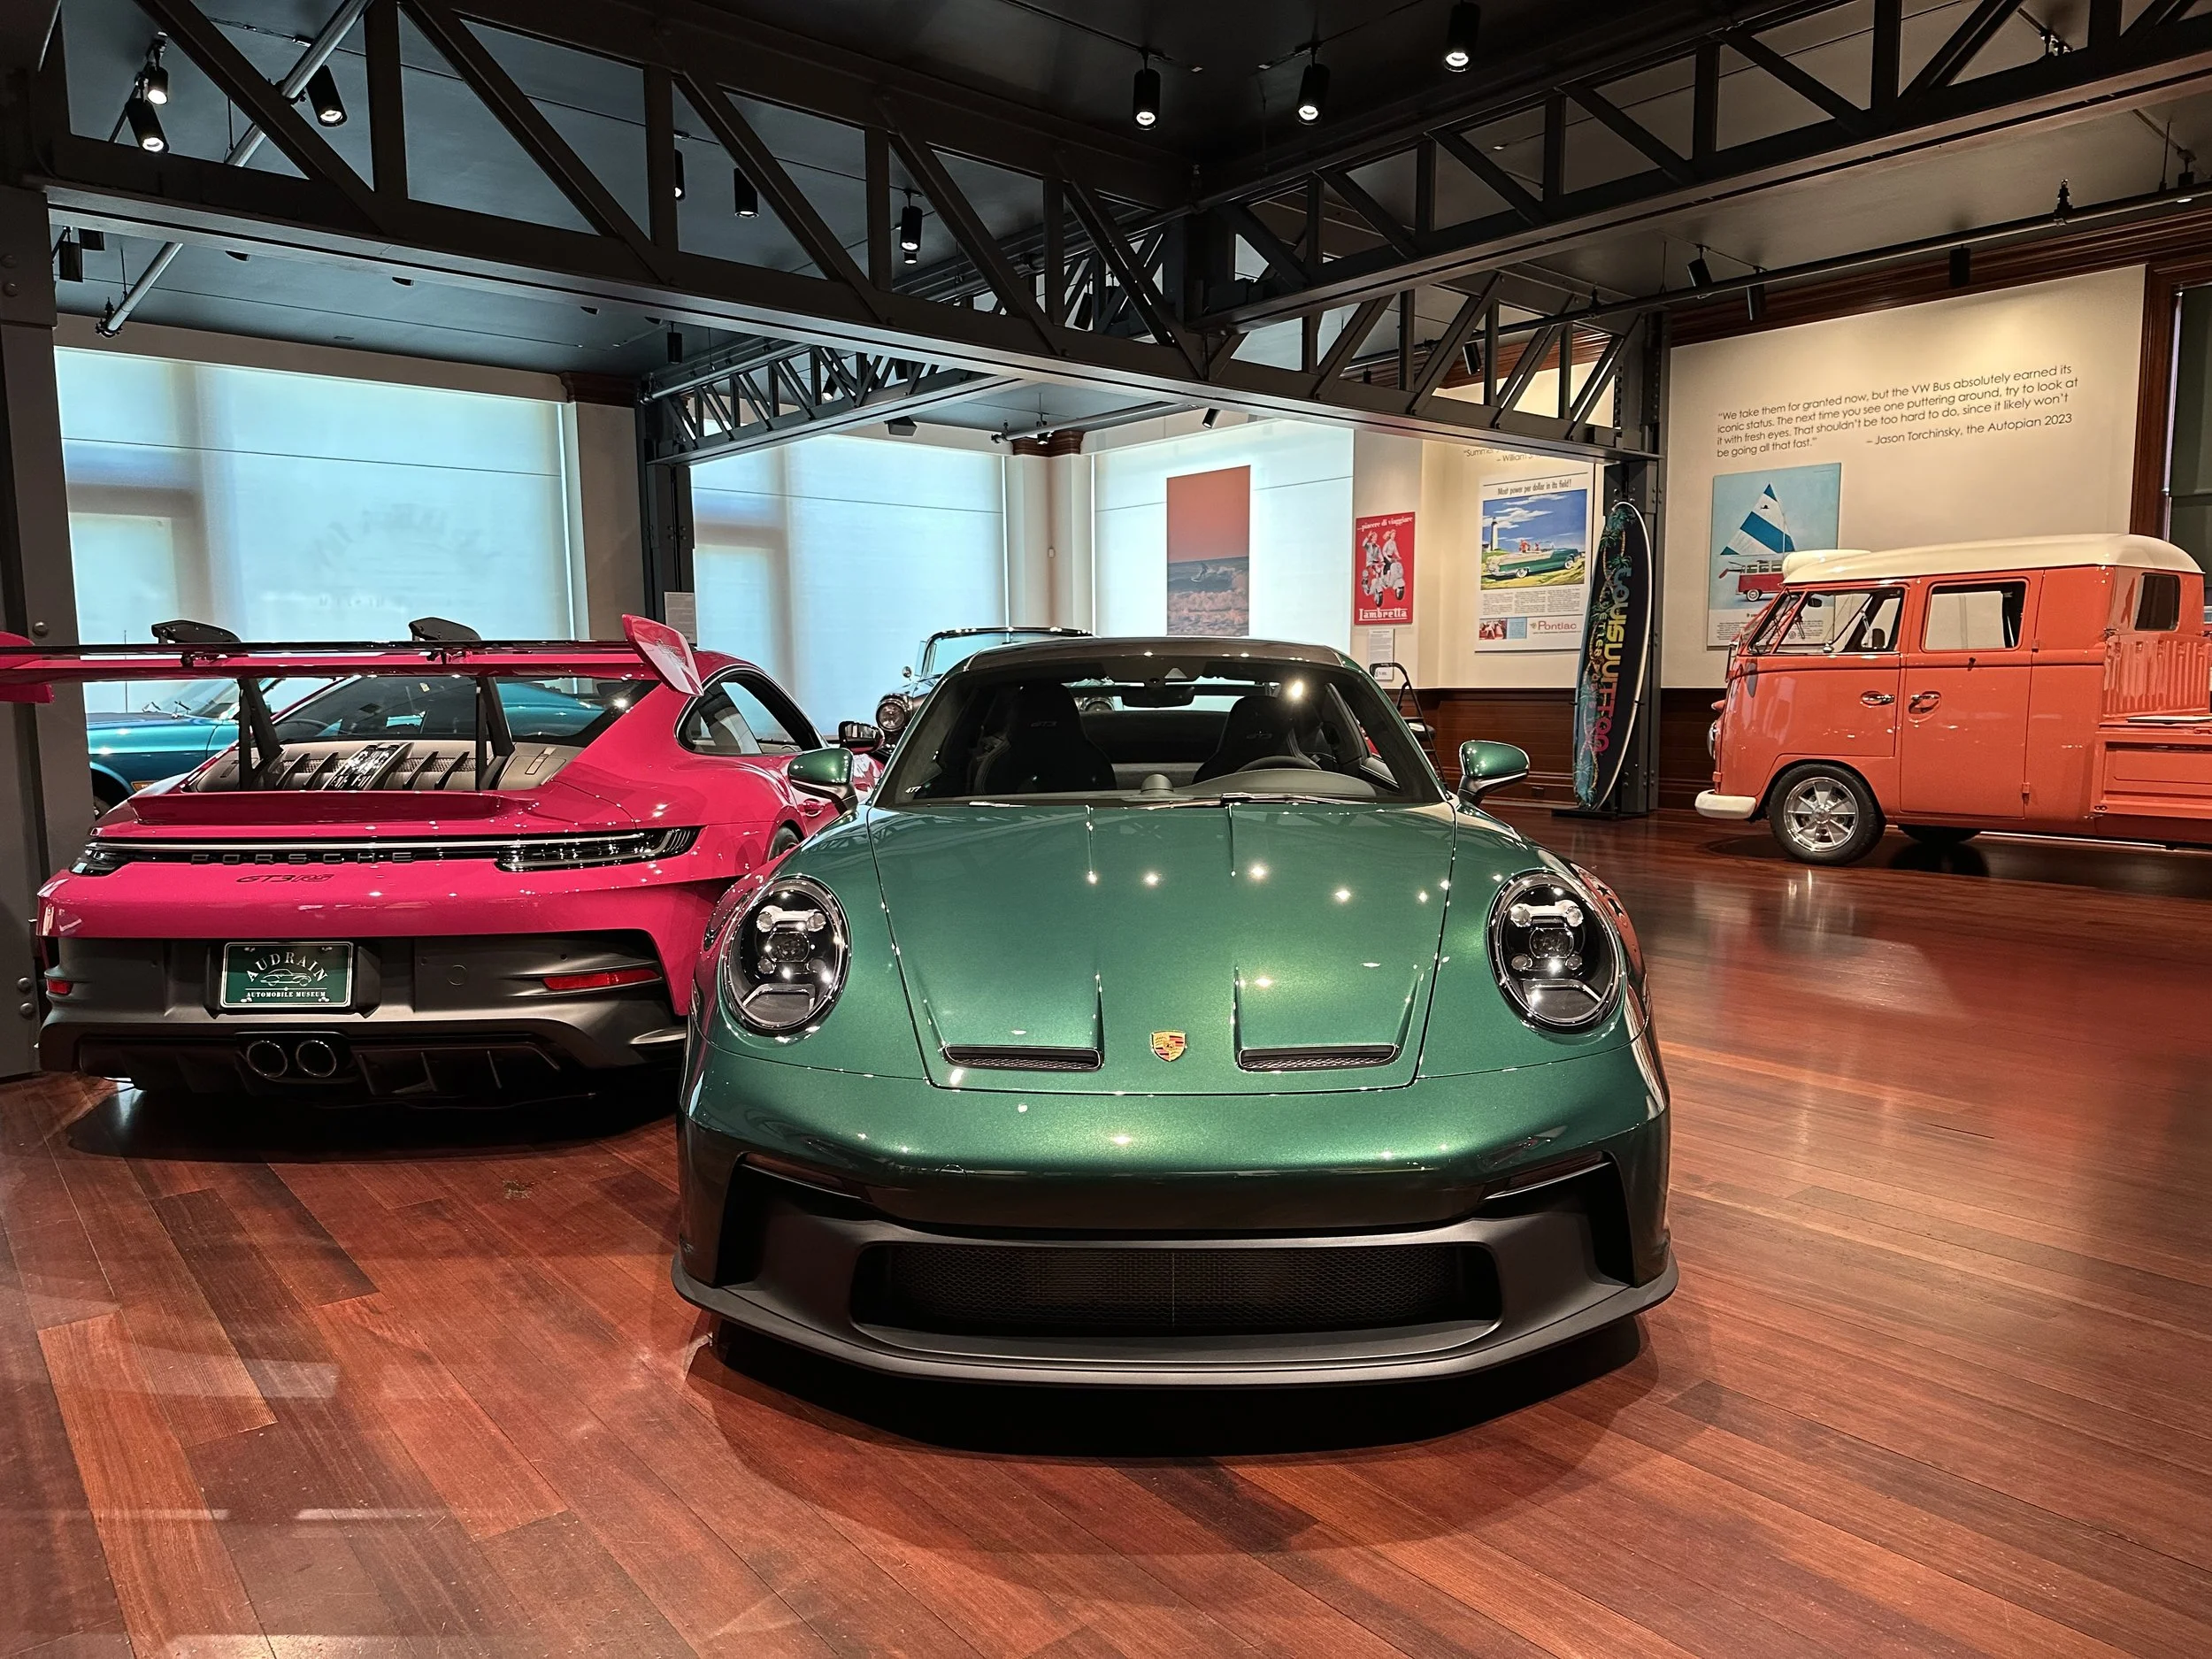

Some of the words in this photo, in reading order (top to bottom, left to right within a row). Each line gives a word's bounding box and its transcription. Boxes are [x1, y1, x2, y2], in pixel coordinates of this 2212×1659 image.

[1718, 411, 1737, 420] "We
[1740, 409, 1759, 419] take
[1763, 405, 1786, 415] them
[1788, 402, 1801, 411] for
[1802, 396, 1842, 411] granted
[1845, 394, 1869, 404] now,
[1872, 390, 1889, 400] but
[1892, 388, 1909, 396] the
[1912, 383, 1930, 394] VW
[1932, 382, 1950, 392] Bus
[1954, 373, 2010, 389] absolutely
[2014, 365, 2057, 380] earned
[2060, 365, 2072, 375] its
[1717, 423, 1745, 434] iconic
[1747, 419, 1775, 430] status.
[1796, 414, 1816, 423] next
[1819, 410, 1839, 419] time
[1842, 409, 1862, 419] you
[1863, 405, 1881, 414] see
[1884, 402, 1904, 411] one
[1908, 396, 1955, 410] puttering
[1958, 388, 2001, 403] around,
[2006, 386, 2019, 396] try
[2023, 384, 2035, 393] to
[2037, 380, 2062, 391] look
[2065, 377, 2078, 388] at
[1717, 436, 1722, 445] it
[1724, 434, 1742, 444] with
[1745, 432, 1765, 442] fresh
[1768, 430, 1791, 440] eyes.
[1794, 425, 1814, 435] That
[1816, 419, 1862, 434] shouldn't
[1863, 418, 1878, 426] be
[1881, 416, 1898, 425] too
[1901, 411, 1925, 422] hard
[1929, 410, 1939, 419] to
[1941, 408, 1960, 418] do,
[1962, 403, 1991, 415] since
[1994, 402, 2001, 411] it
[2004, 398, 2032, 411] likely
[2033, 393, 2069, 405] won't
[1875, 434, 1904, 444] Jason
[1908, 426, 1962, 441] Torchinsky,
[1966, 425, 1985, 434] the
[1987, 418, 2041, 432] Autopian
[2045, 413, 2072, 426] 2023
[1717, 449, 1729, 457] be
[1732, 446, 1757, 457] going
[1759, 442, 1770, 451] all
[1772, 442, 1791, 451] that
[1793, 437, 1817, 449] fast."
[1510, 487, 1523, 495] power
[1532, 482, 1545, 491] dollar
[1559, 479, 1571, 488] field!
[1359, 608, 1409, 621] Lambretta
[1538, 620, 1577, 630] Pontiac
[191, 852, 413, 864] PORSCHE
[246, 951, 328, 982] AUDRAIN
